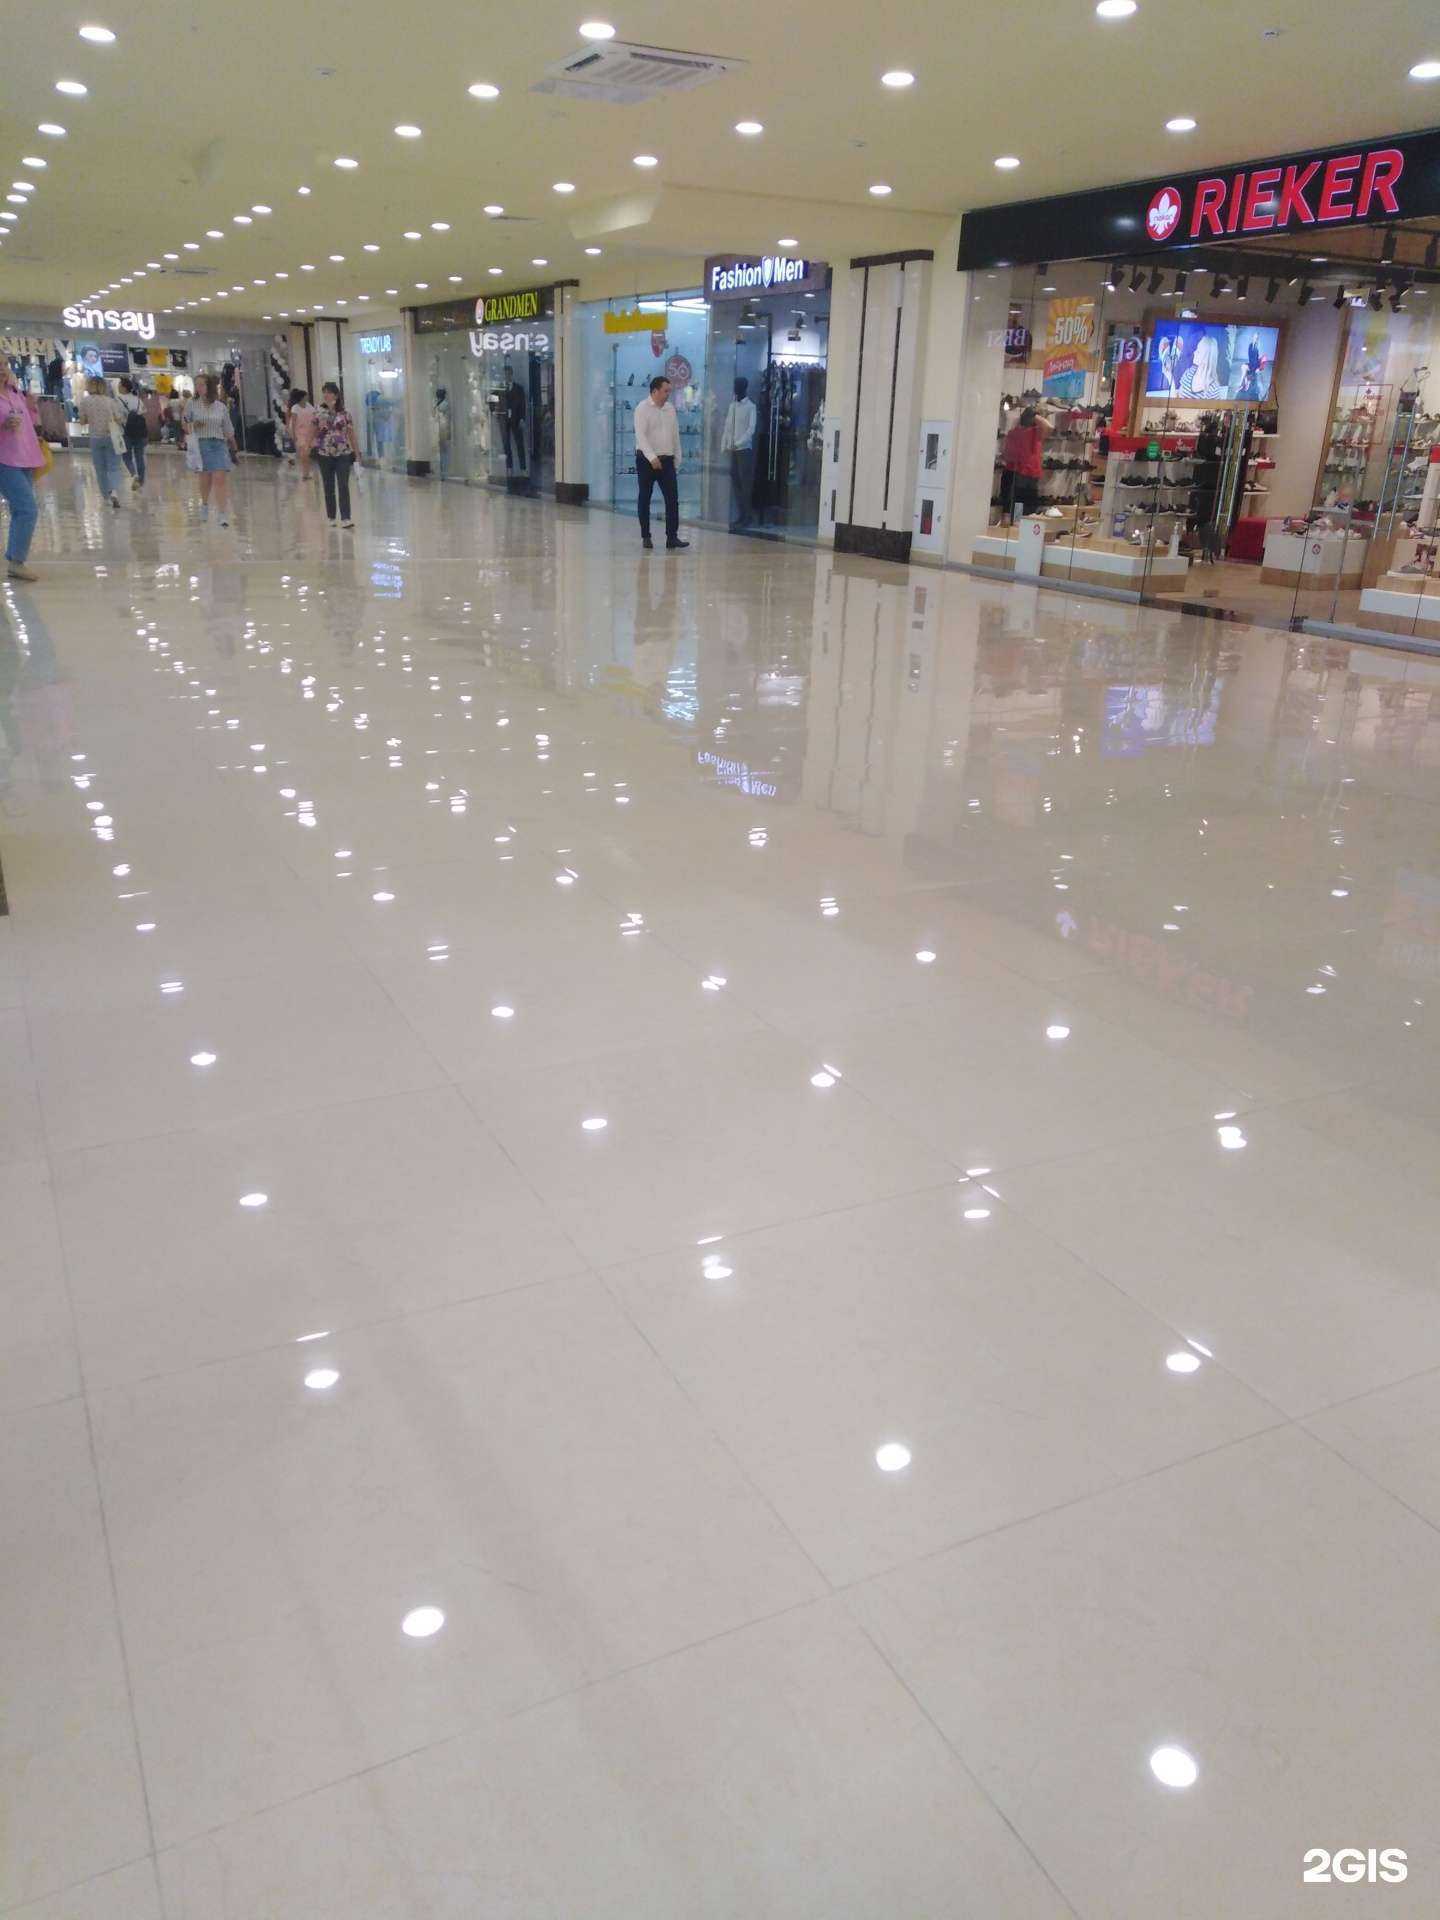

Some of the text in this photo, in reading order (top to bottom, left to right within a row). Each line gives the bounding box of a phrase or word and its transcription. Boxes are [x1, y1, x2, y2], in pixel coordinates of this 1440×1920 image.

[1190, 148, 1405, 238] RIEKER
[711, 257, 804, 291] Fashion Men
[62, 306, 156, 340] sinsay
[485, 291, 538, 321] GRANDMEN
